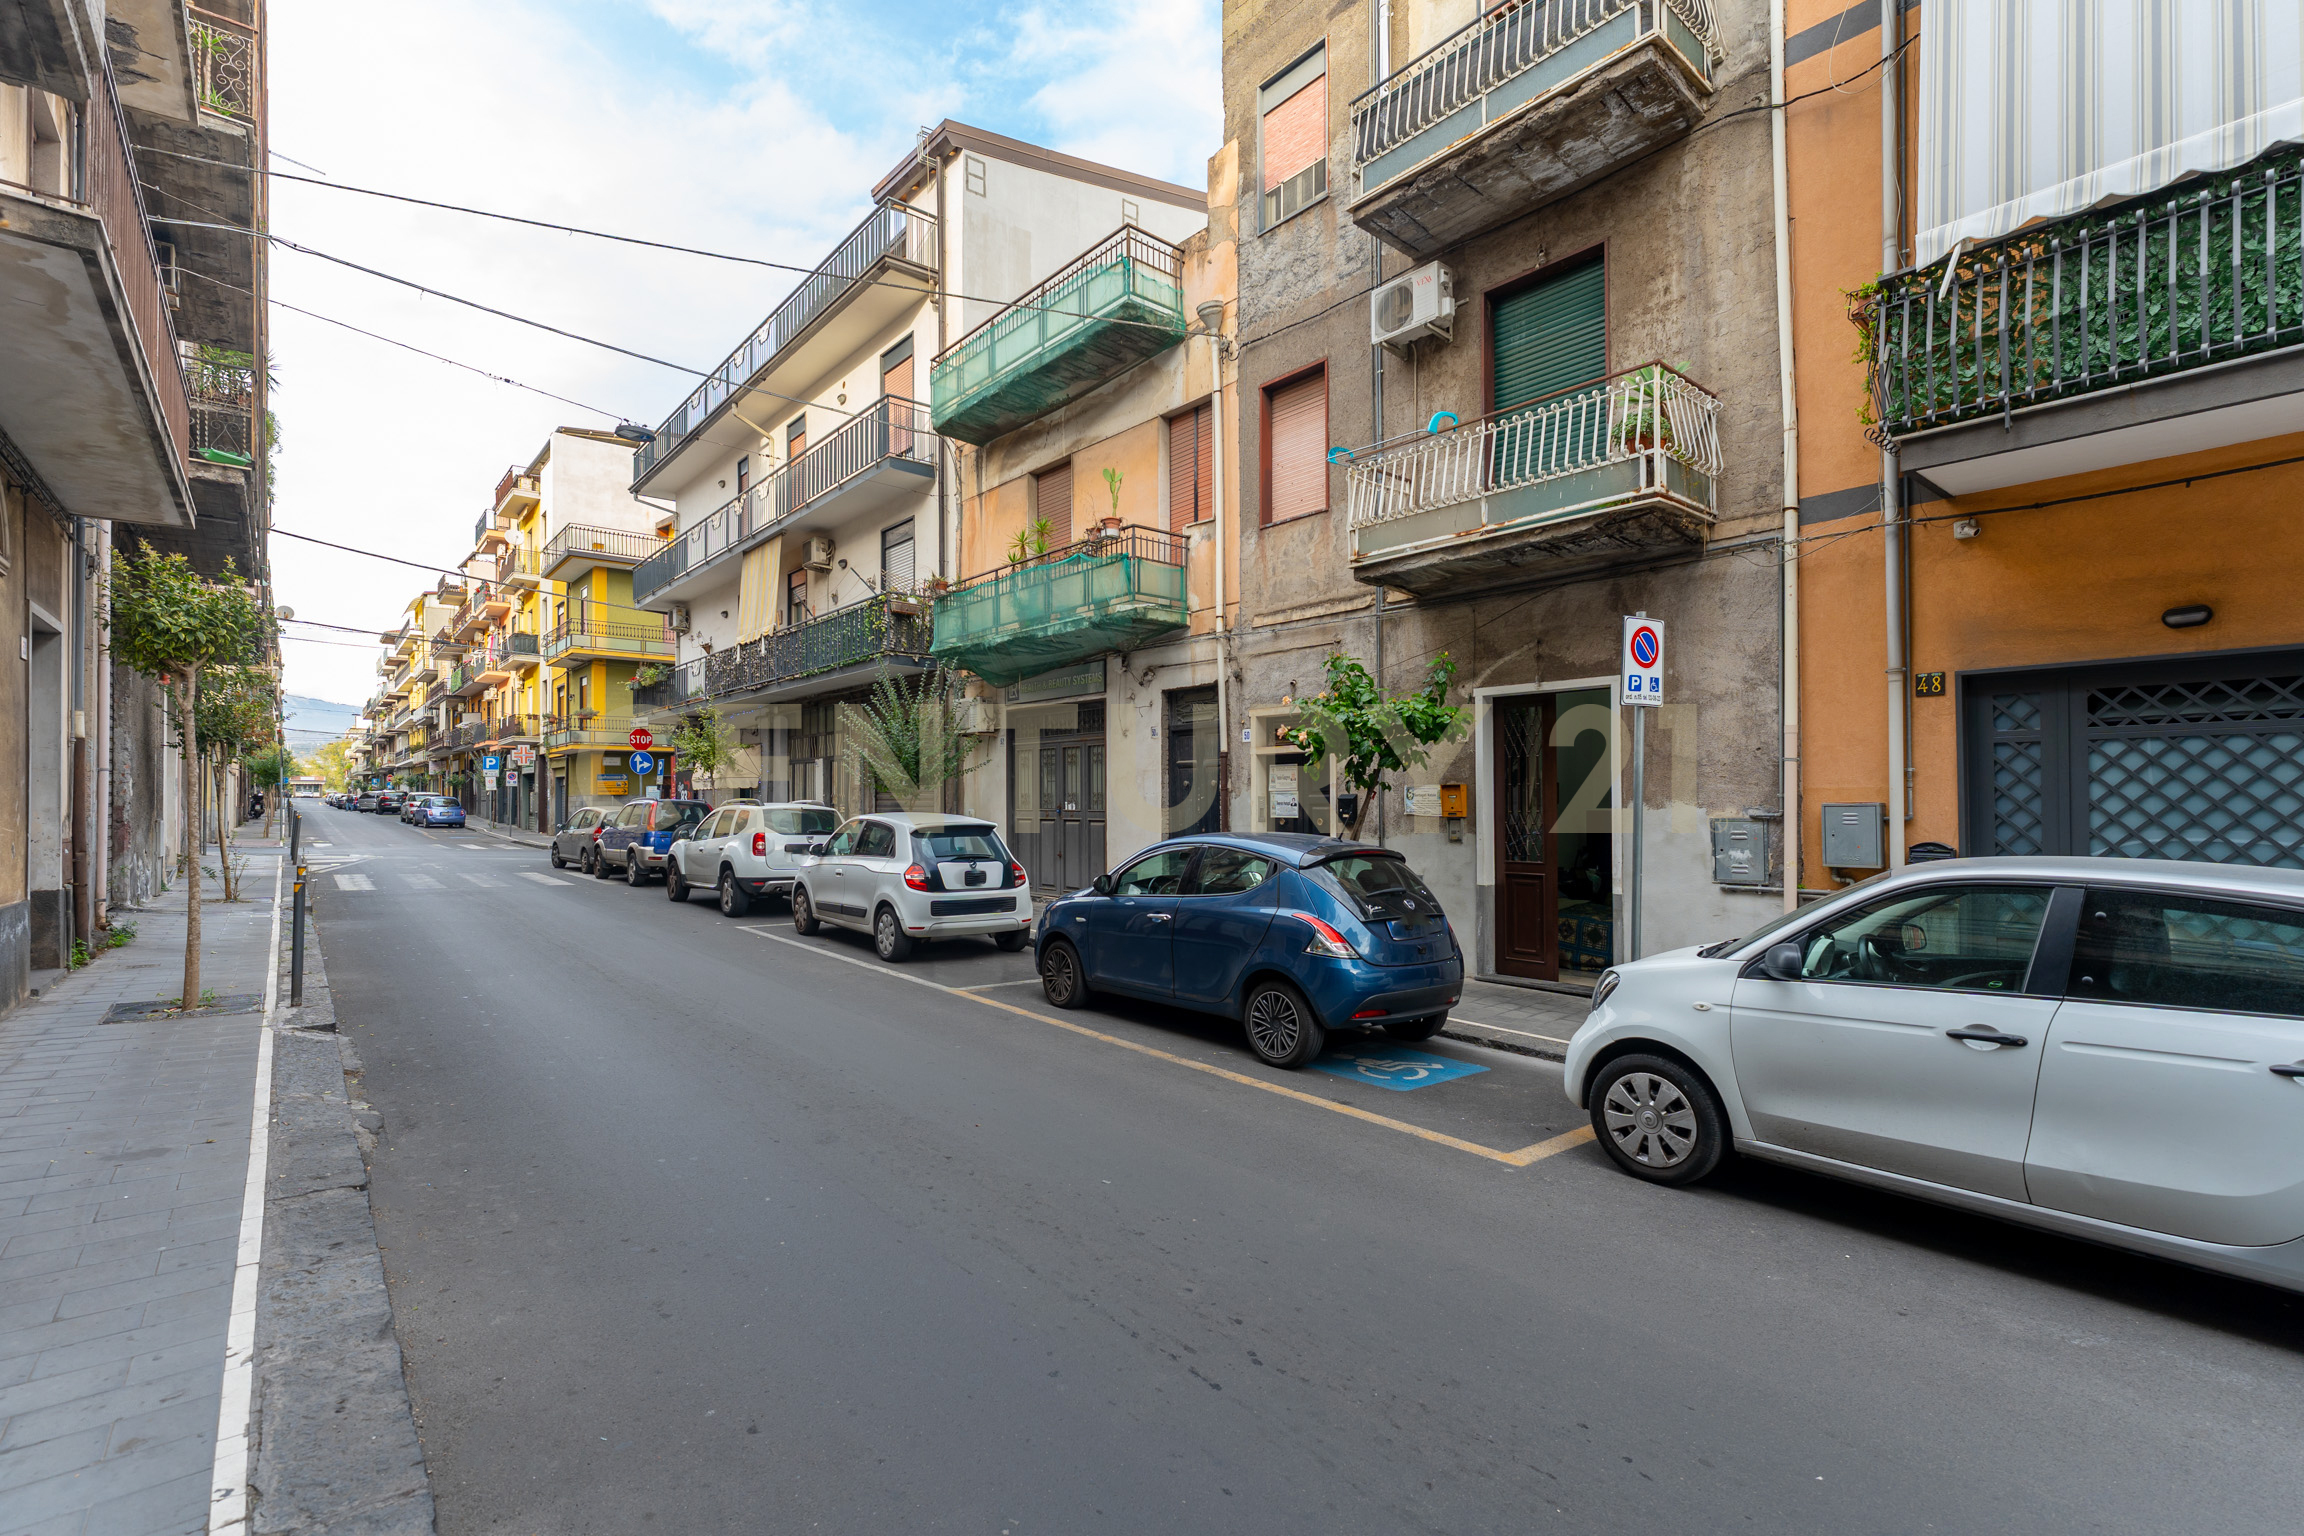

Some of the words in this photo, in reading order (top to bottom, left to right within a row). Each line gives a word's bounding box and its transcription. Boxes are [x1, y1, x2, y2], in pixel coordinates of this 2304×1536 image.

[1021, 682, 1041, 693] HEALTH
[1049, 677, 1072, 689] BEAUTY
[1073, 671, 1103, 685] SYSTEMS
[1632, 677, 1640, 689] P
[1917, 676, 1941, 692] 48
[631, 735, 652, 744] STOP
[486, 758, 496, 768] P
